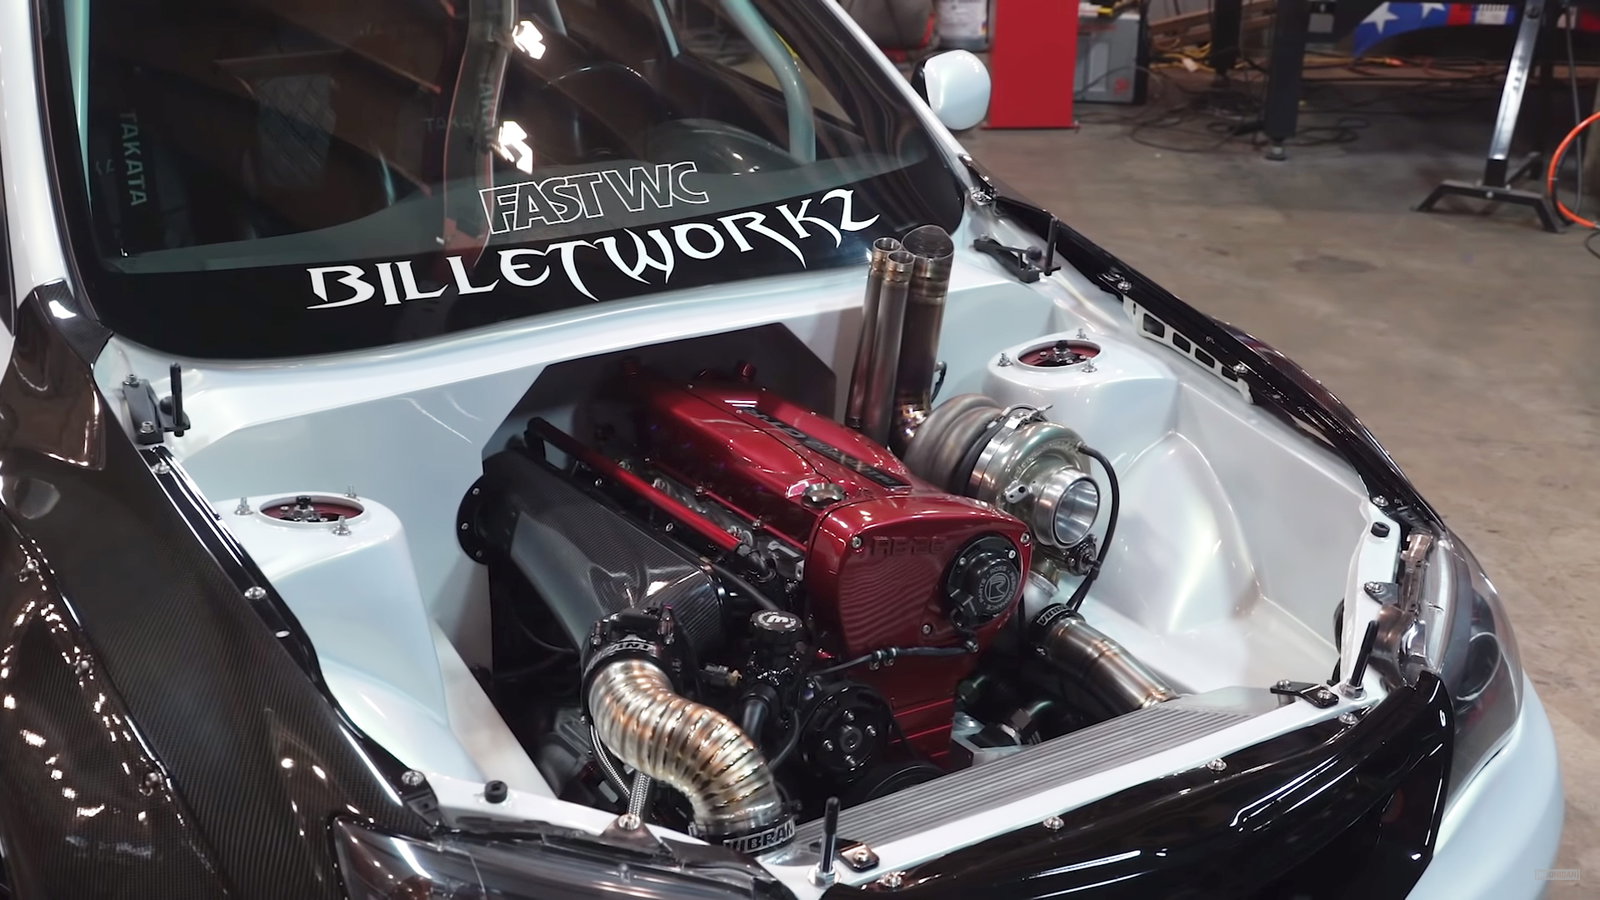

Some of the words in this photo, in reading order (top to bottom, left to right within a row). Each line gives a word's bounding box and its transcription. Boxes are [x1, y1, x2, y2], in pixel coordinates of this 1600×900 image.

[119, 109, 148, 207] TAKATA
[479, 171, 604, 235] FAST
[306, 189, 880, 309] BILLETWORKZ
